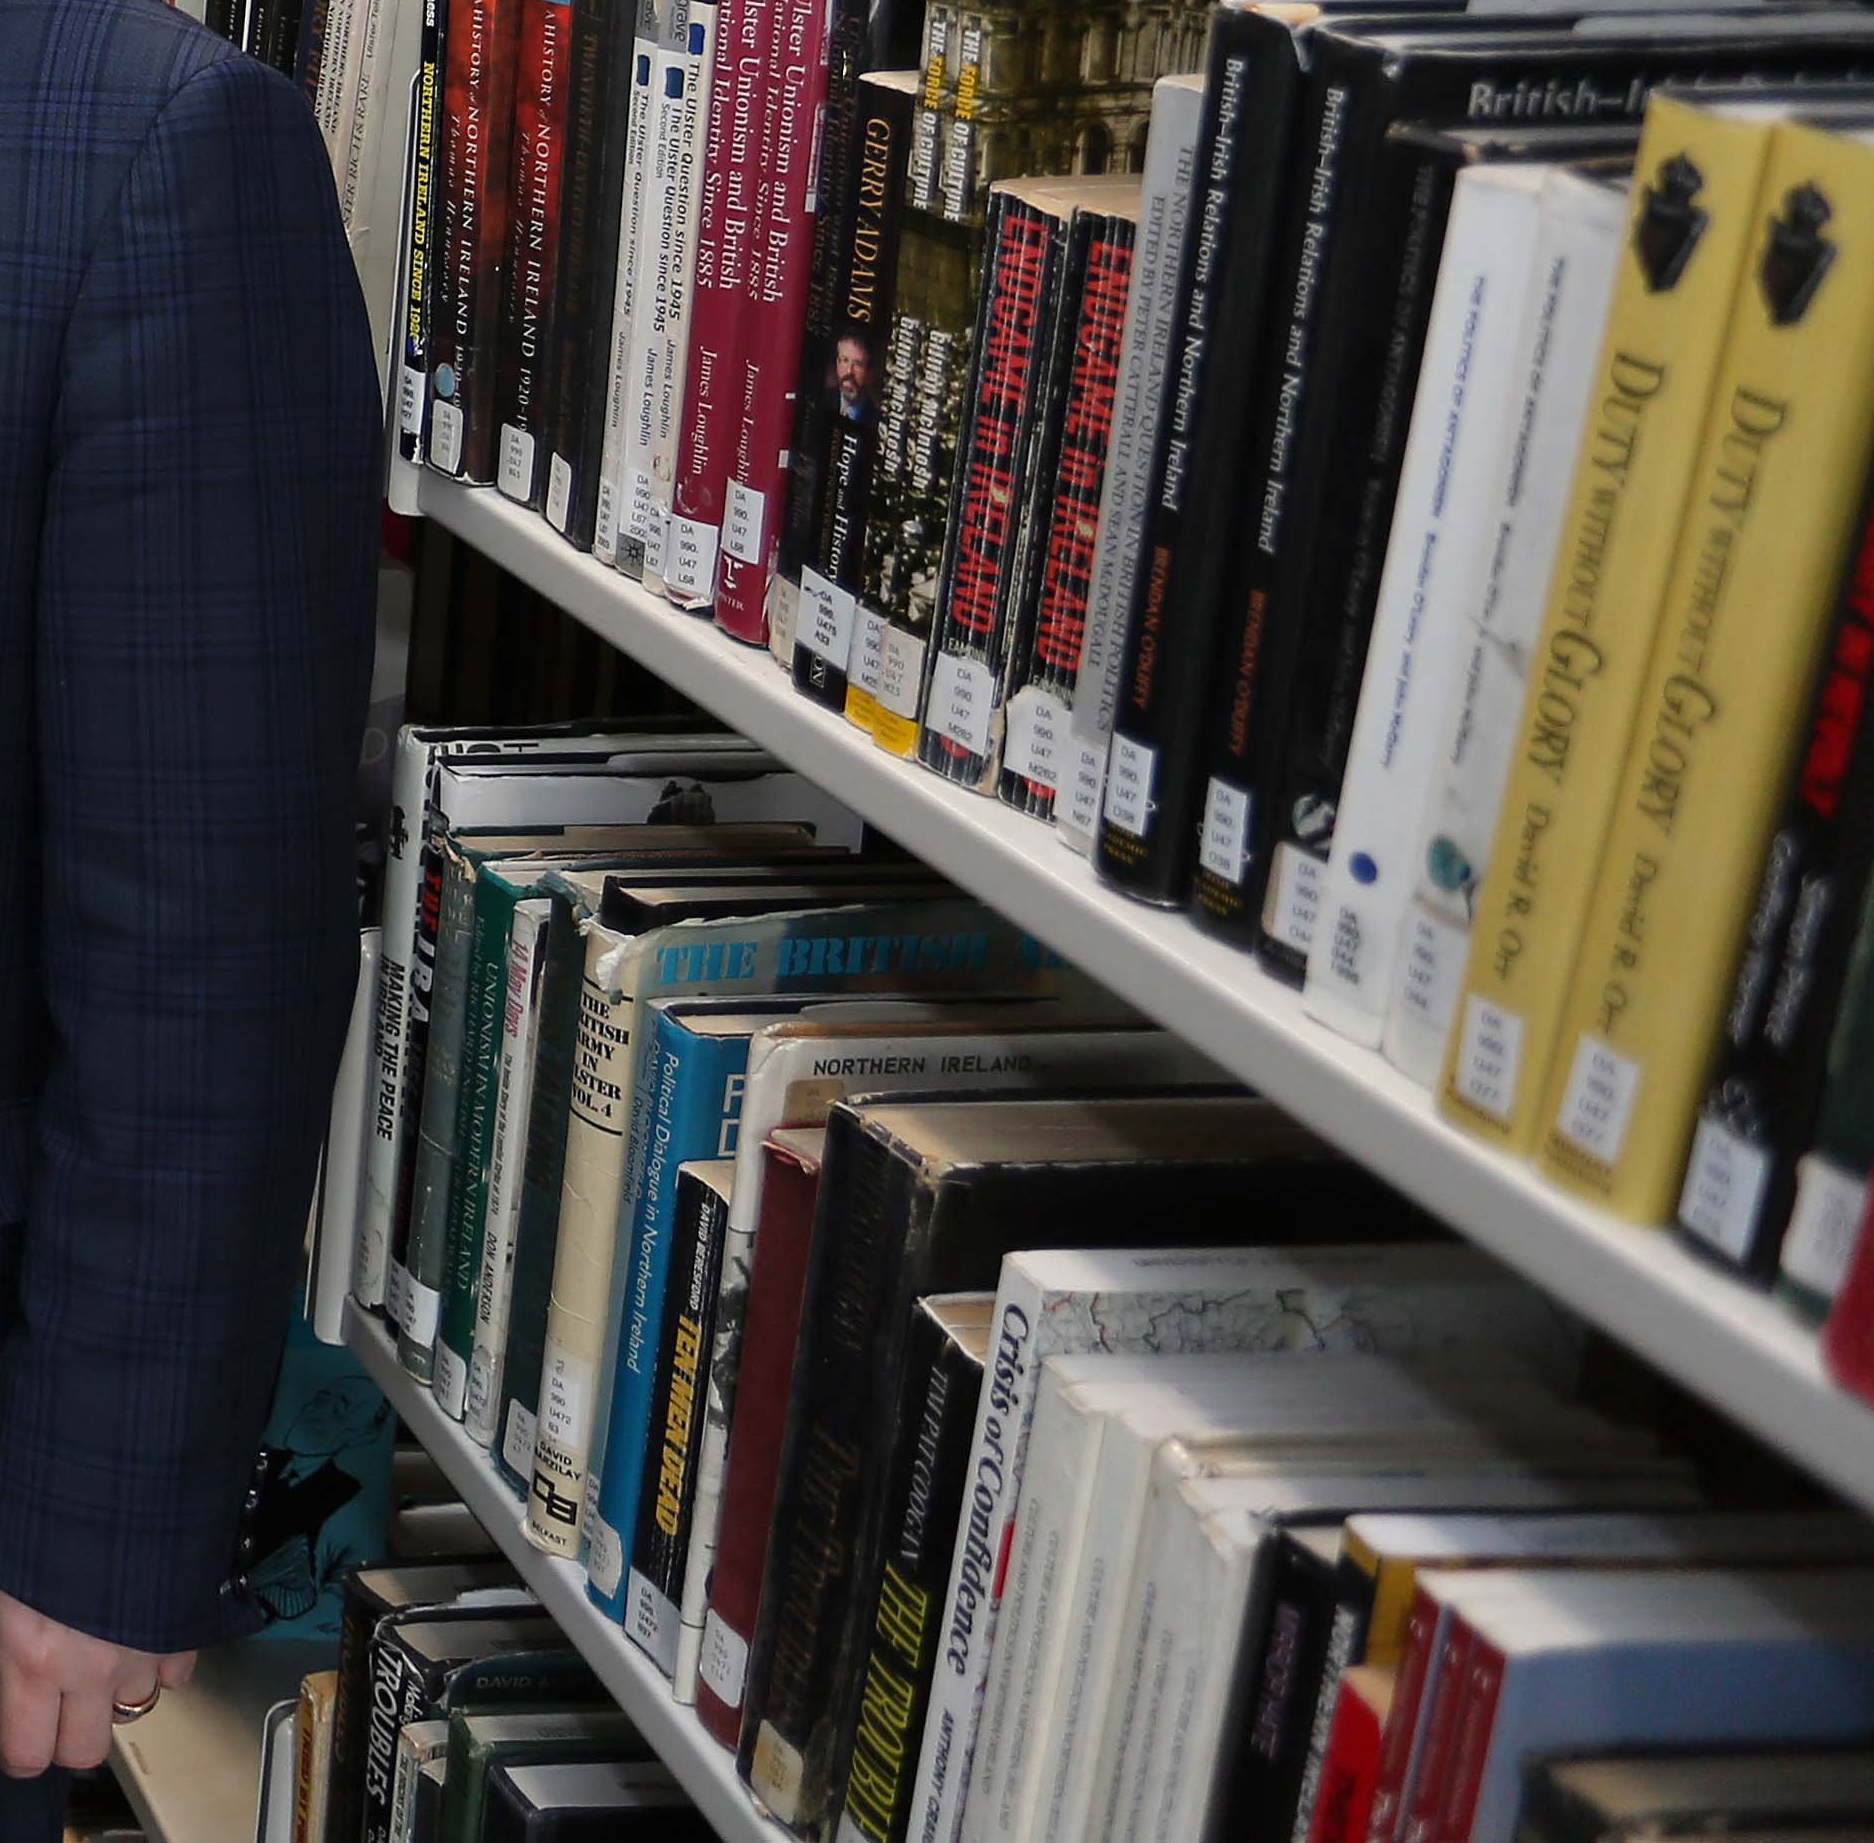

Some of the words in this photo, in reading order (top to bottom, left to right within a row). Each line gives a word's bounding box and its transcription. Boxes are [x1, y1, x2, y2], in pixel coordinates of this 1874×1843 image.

[416, 61, 436, 157] NORTHERN
[727, 69, 761, 169] Unionism
[771, 62, 806, 166] Unionism
[413, 158, 432, 245] IRELAND
[726, 173, 752, 210] and
[769, 171, 793, 207] and
[854, 116, 894, 222] GERRY
[409, 247, 427, 302] SINCE
[716, 215, 749, 291] British
[760, 212, 791, 304] British
[845, 226, 882, 323] ADAMS
[979, 213, 1053, 419] ENDGAME
[1060, 239, 1137, 444] ENDGAME
[696, 345, 719, 398] James
[689, 401, 714, 477] Loughlin
[980, 427, 1015, 461] in
[1061, 454, 1104, 493] in
[949, 465, 1013, 635] IRELAND
[1030, 499, 1103, 670] IRELAND
[381, 959, 406, 1038] MAKING
[378, 1041, 400, 1079] THE
[811, 1056, 928, 1078] NORTHERN
[936, 1055, 1035, 1074] IRELAND
[375, 1080, 397, 1141] PEACE
[695, 1202, 713, 1242] DAVID
[687, 1243, 708, 1311] BERESFORD
[673, 1313, 703, 1376] TEN
[988, 1302, 1031, 1413] Crisis
[665, 1376, 697, 1436] MEN
[981, 1415, 1012, 1462] of
[654, 1433, 689, 1536] DEAD
[944, 1459, 1005, 1677] Confidence
